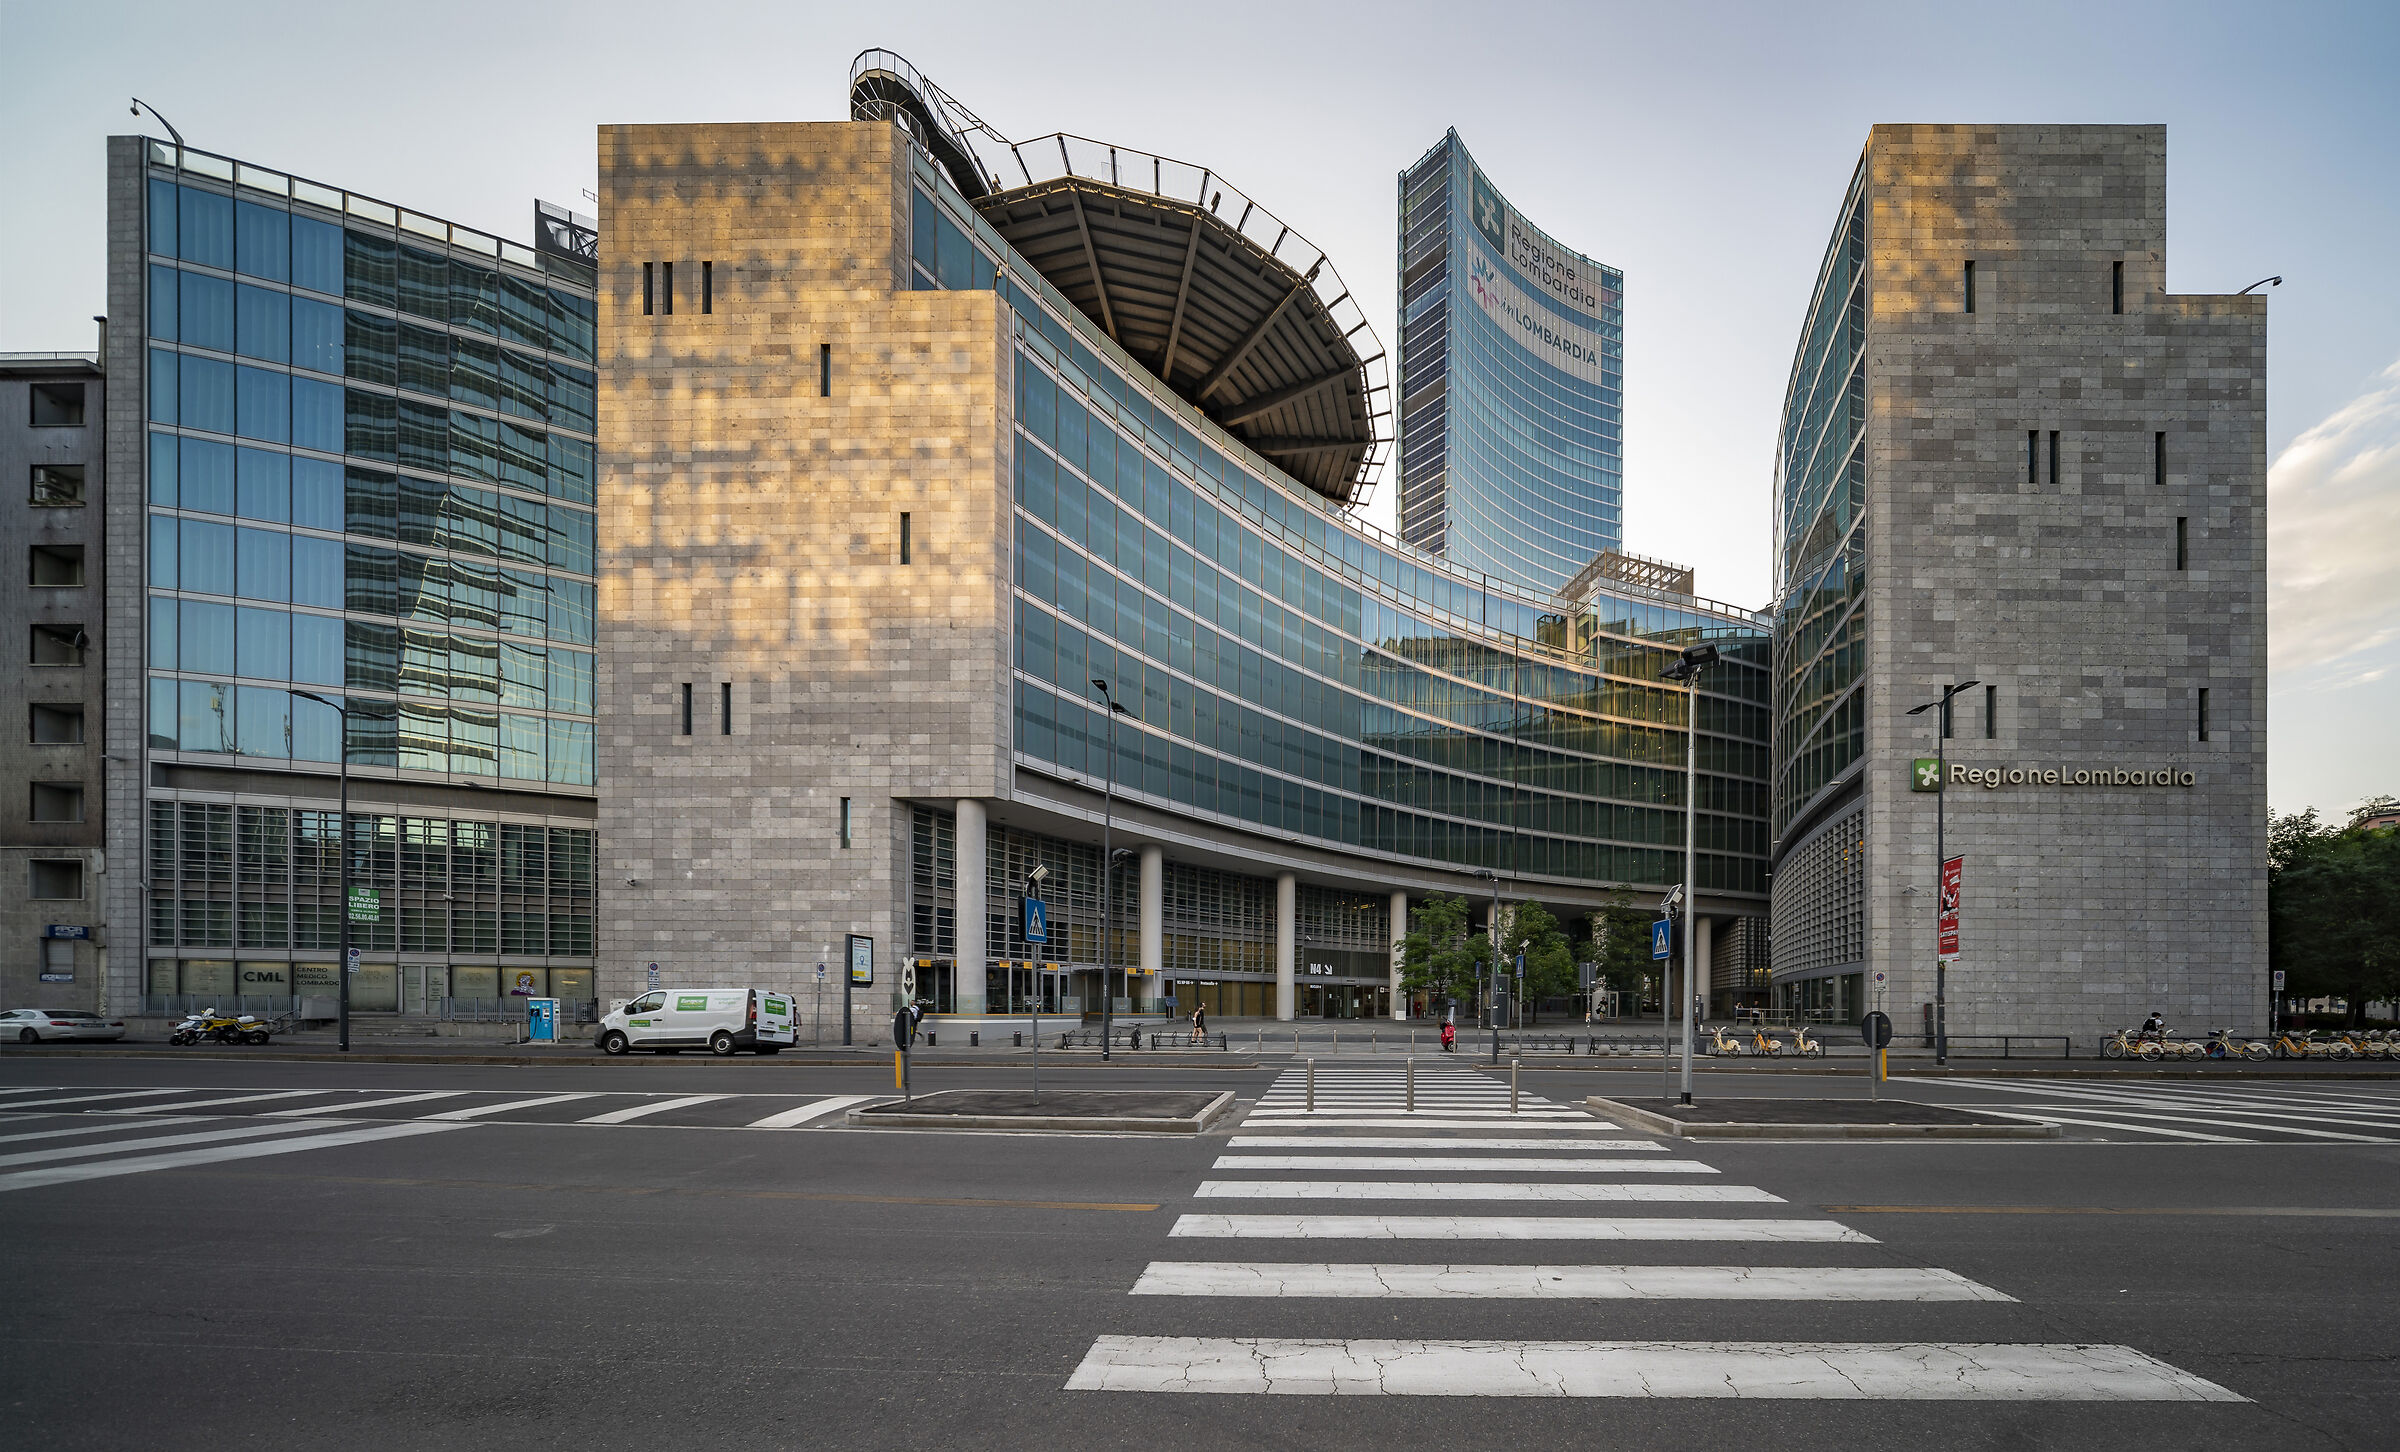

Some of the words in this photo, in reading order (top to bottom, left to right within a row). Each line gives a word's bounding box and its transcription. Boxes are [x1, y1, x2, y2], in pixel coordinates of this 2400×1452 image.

[1511, 224, 1576, 280] Regione
[1511, 242, 1596, 309] Lombardia
[244, 972, 284, 982] CML
